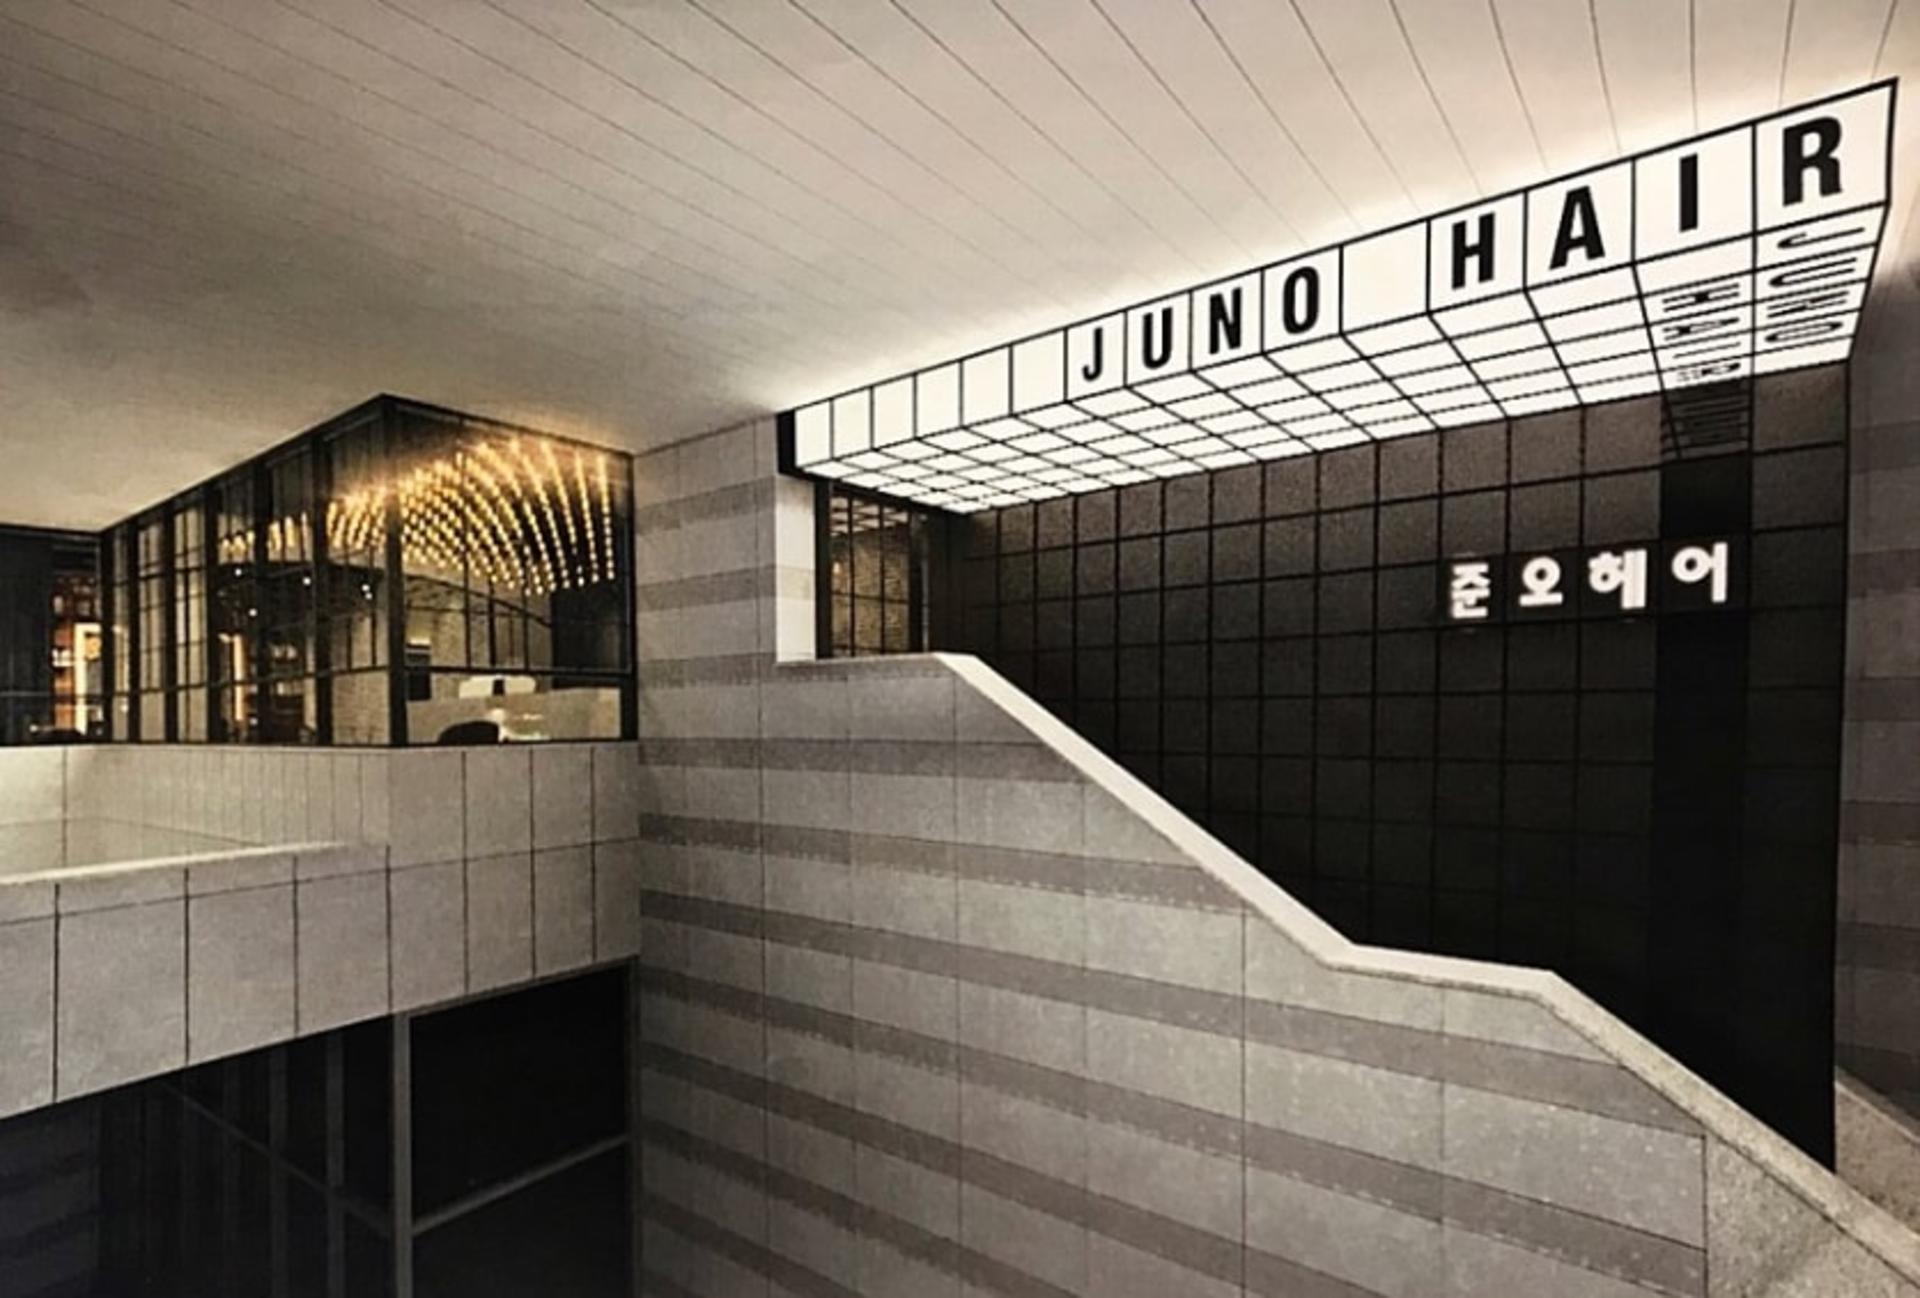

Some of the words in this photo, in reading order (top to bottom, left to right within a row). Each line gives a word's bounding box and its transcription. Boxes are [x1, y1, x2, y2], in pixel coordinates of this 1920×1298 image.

[1082, 266, 1319, 382] JUNO
[1451, 116, 1843, 291] HAIR
[1450, 542, 1728, 619] 준오헤어
